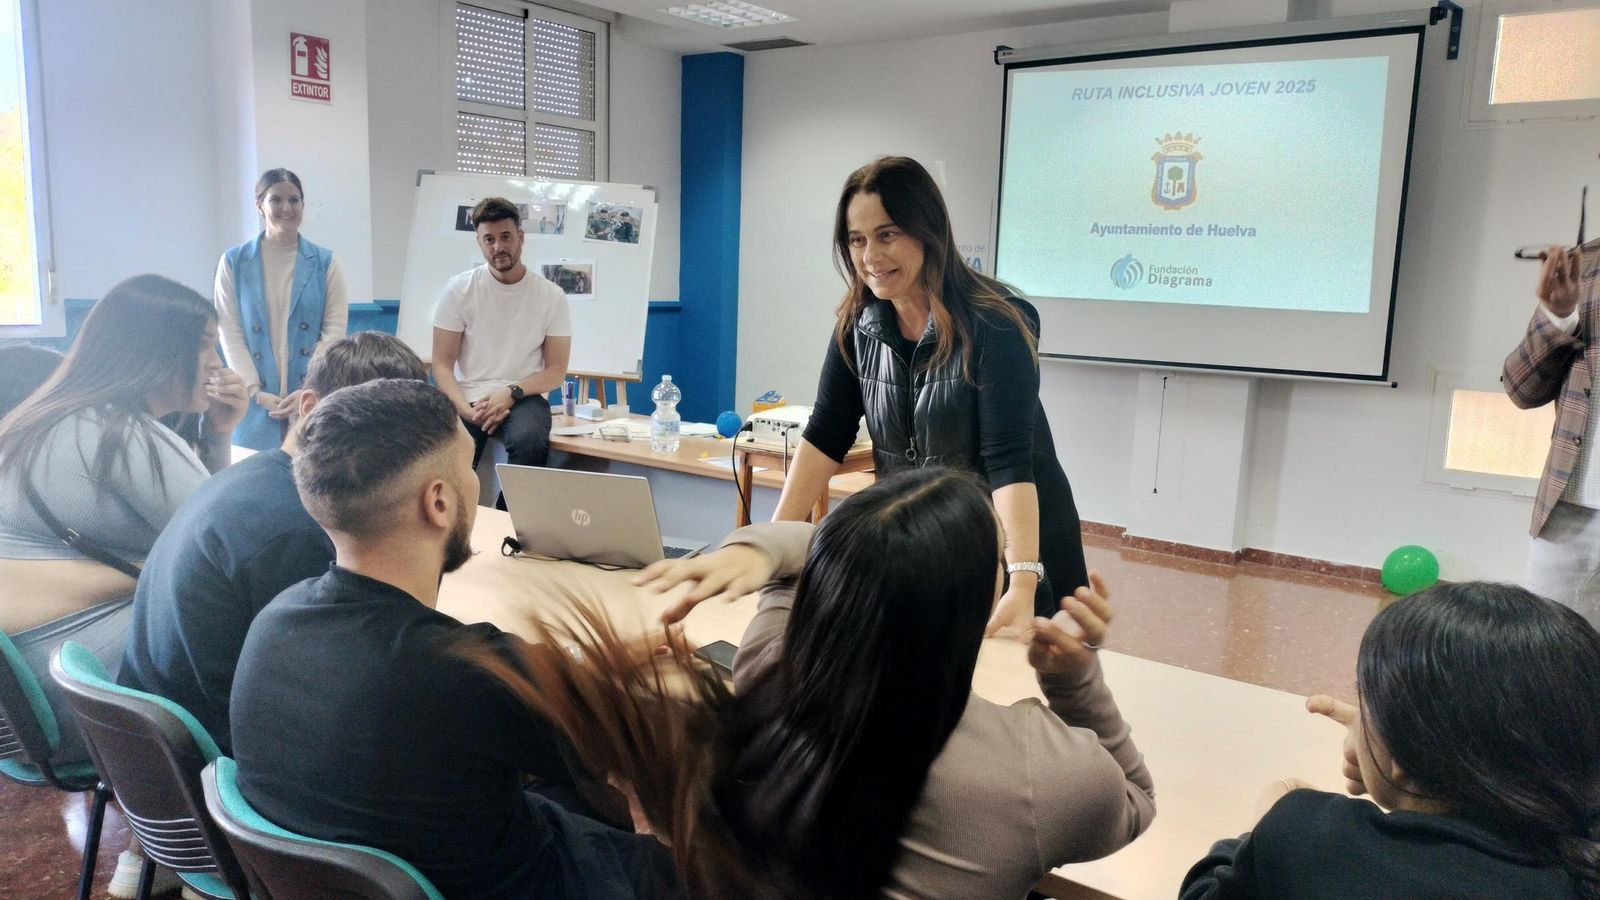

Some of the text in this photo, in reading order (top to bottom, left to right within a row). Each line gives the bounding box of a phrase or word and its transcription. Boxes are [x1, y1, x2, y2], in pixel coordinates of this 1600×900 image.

[293, 82, 329, 98] EXTINTOR
[1071, 79, 1317, 101] RUTA INCLUSIVA JOVEN 2025
[1090, 222, 1257, 237] Ayuntamiento de Huelva
[1149, 264, 1198, 274] Fundación
[1148, 274, 1213, 288] Diagrama
[574, 508, 588, 526] hp
